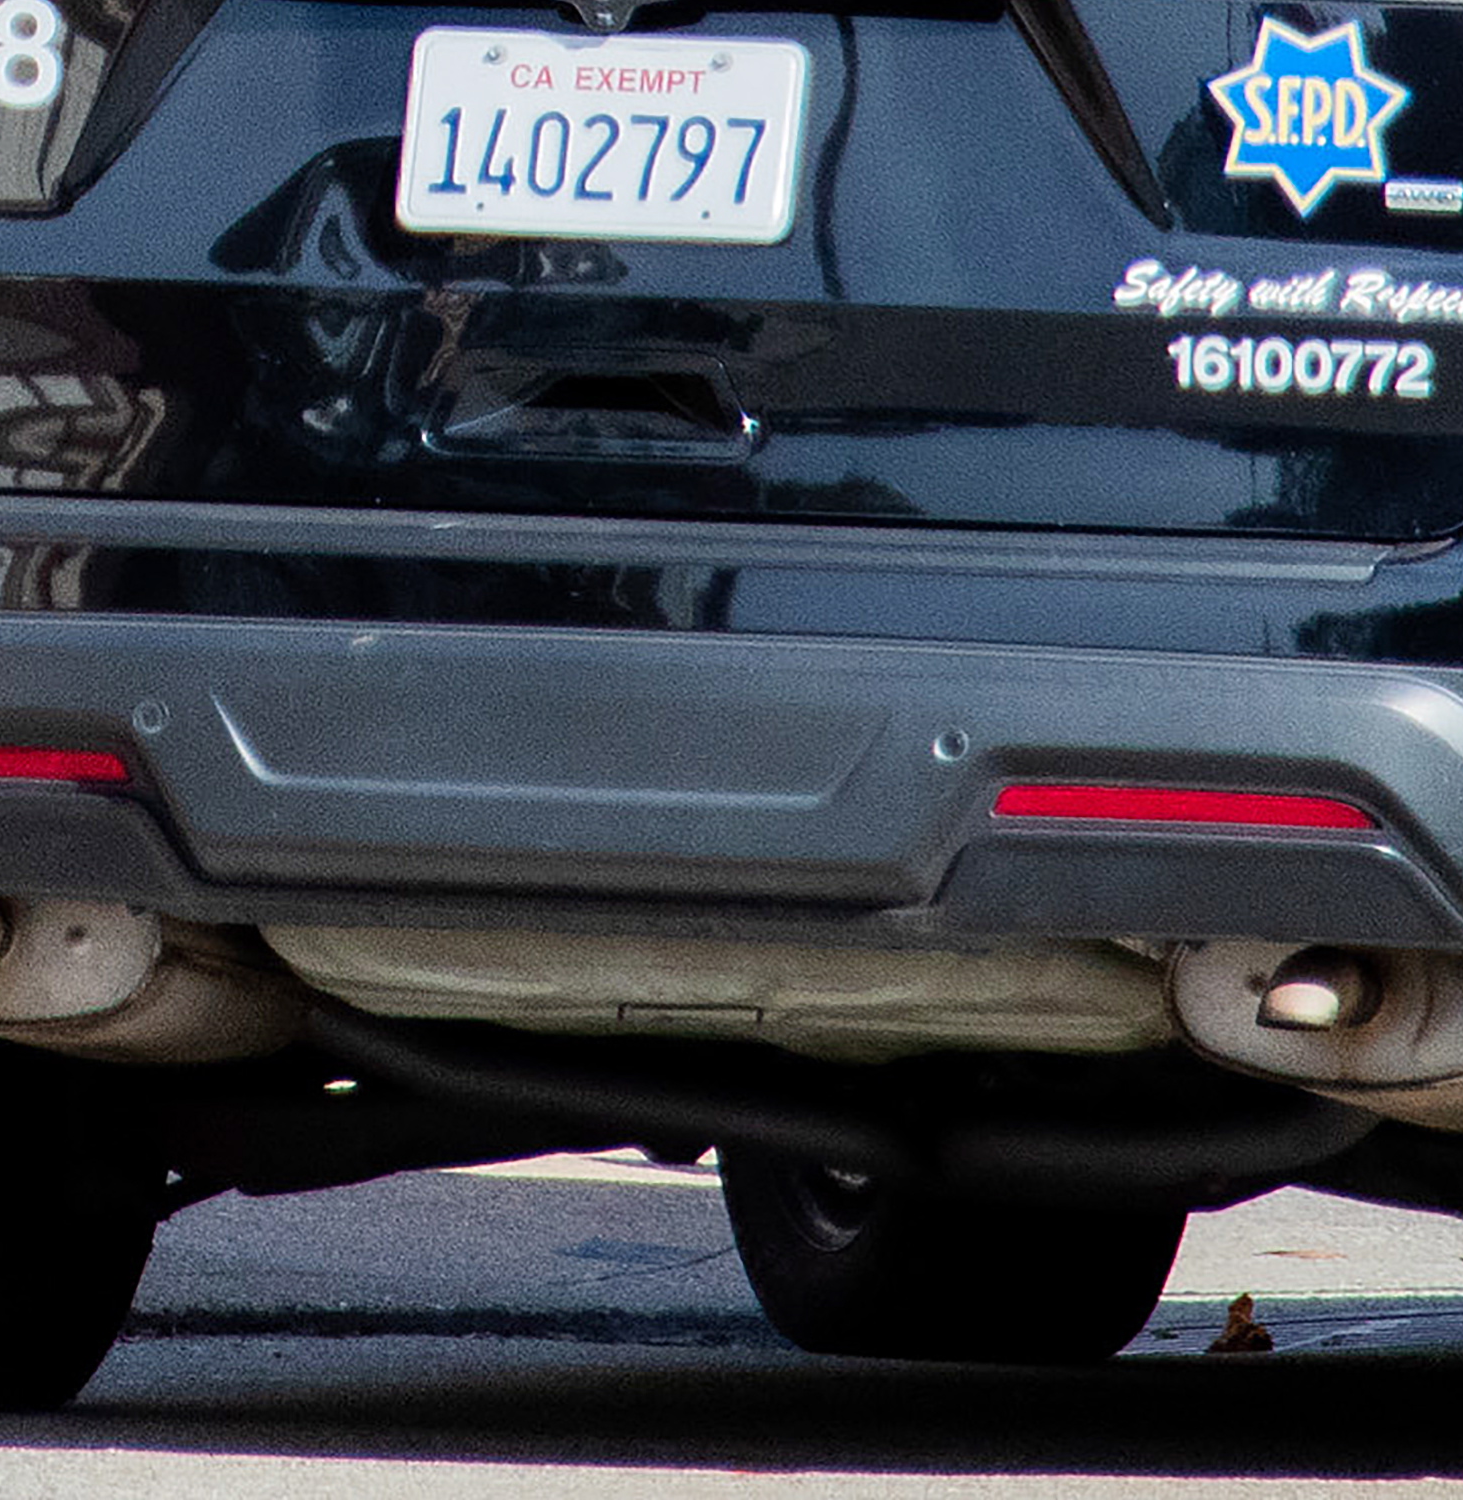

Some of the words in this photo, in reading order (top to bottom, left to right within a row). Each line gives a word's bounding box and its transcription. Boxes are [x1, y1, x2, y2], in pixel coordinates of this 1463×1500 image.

[510, 64, 554, 91] CA
[575, 66, 707, 95] EXEMPT
[1243, 76, 1367, 148] S.F.P.D.
[427, 106, 767, 205] 1402797
[1114, 257, 1243, 317] Safety
[1249, 268, 1336, 312] with
[1168, 335, 1435, 399] 16100772
